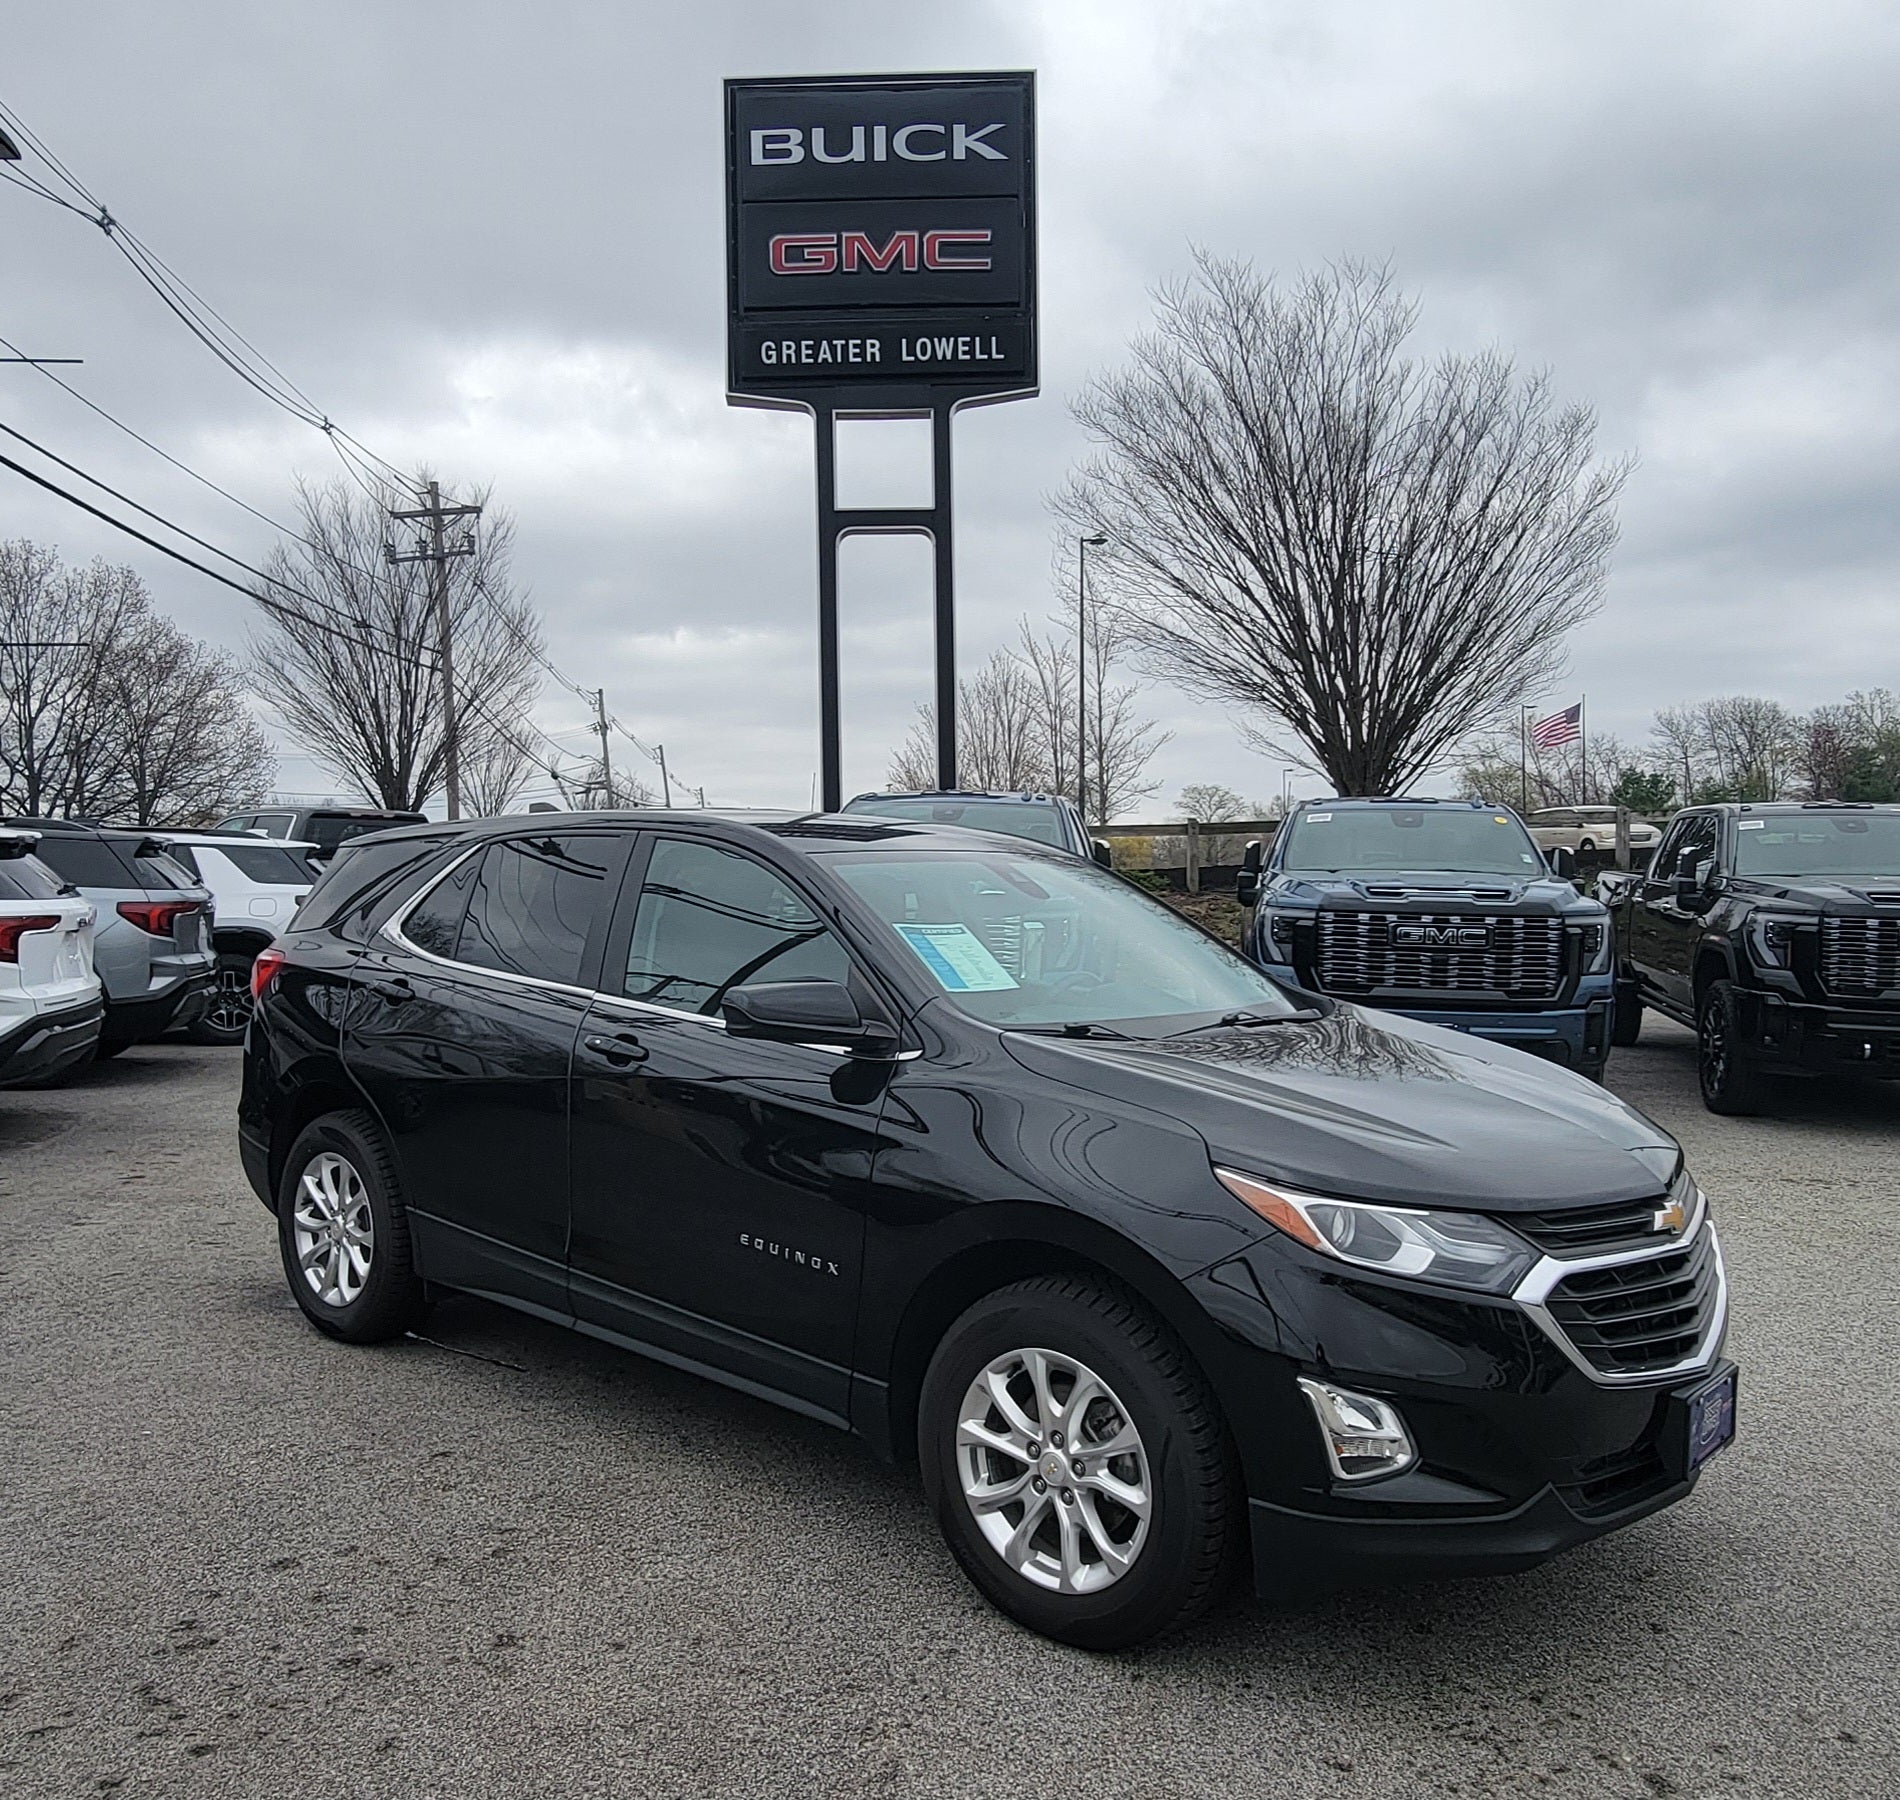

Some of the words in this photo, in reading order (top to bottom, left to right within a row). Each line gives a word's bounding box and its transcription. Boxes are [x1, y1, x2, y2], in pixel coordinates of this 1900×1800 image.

[750, 123, 1009, 166] BUICK
[769, 229, 992, 275] GMC
[760, 339, 881, 364] GREATER
[901, 336, 1005, 361] LOWELL
[1396, 926, 1487, 945] GMC
[740, 1233, 839, 1276] EQUINOX
